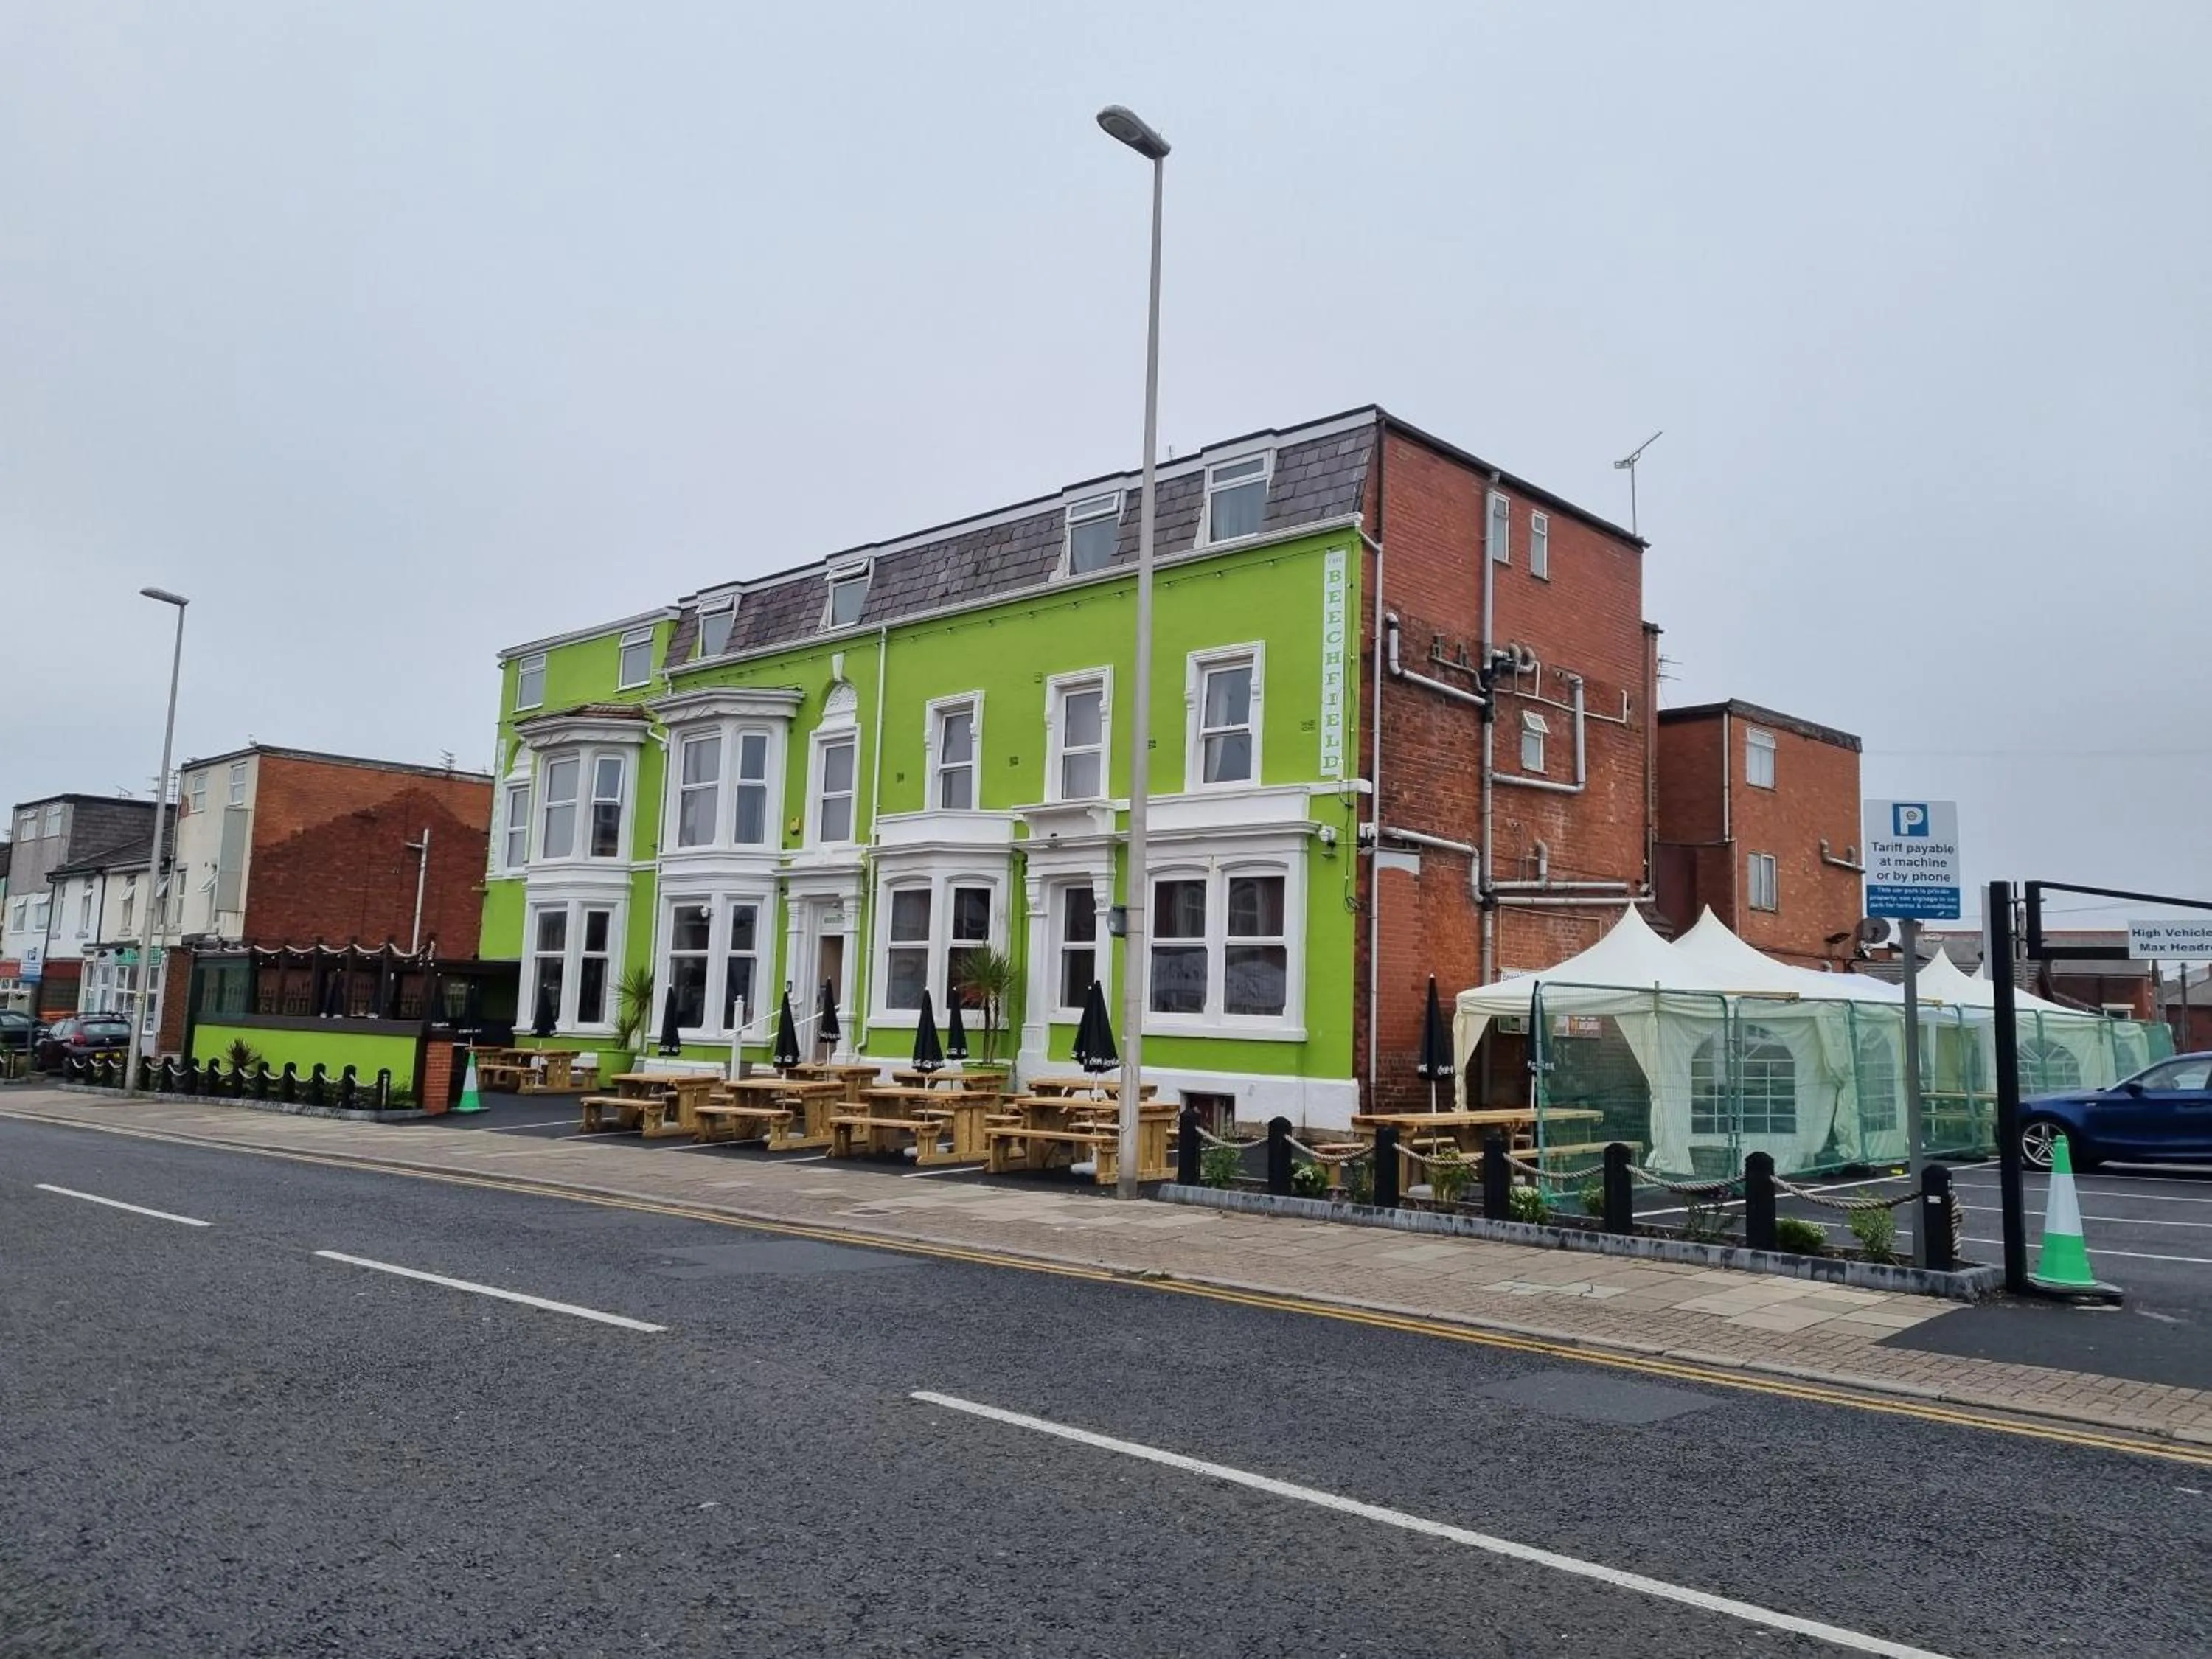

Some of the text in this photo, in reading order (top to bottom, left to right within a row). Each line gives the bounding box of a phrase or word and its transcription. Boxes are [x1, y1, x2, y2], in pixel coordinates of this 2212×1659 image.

[1323, 568, 1341, 768] BEECHFIELD
[1899, 806, 1924, 835] P
[1871, 842, 1955, 855] Tariff payable
[1879, 858, 1947, 868] at machine
[1877, 871, 1950, 883] or by phone
[2132, 928, 2212, 939] High Vehicle
[2139, 943, 2166, 952] Max
